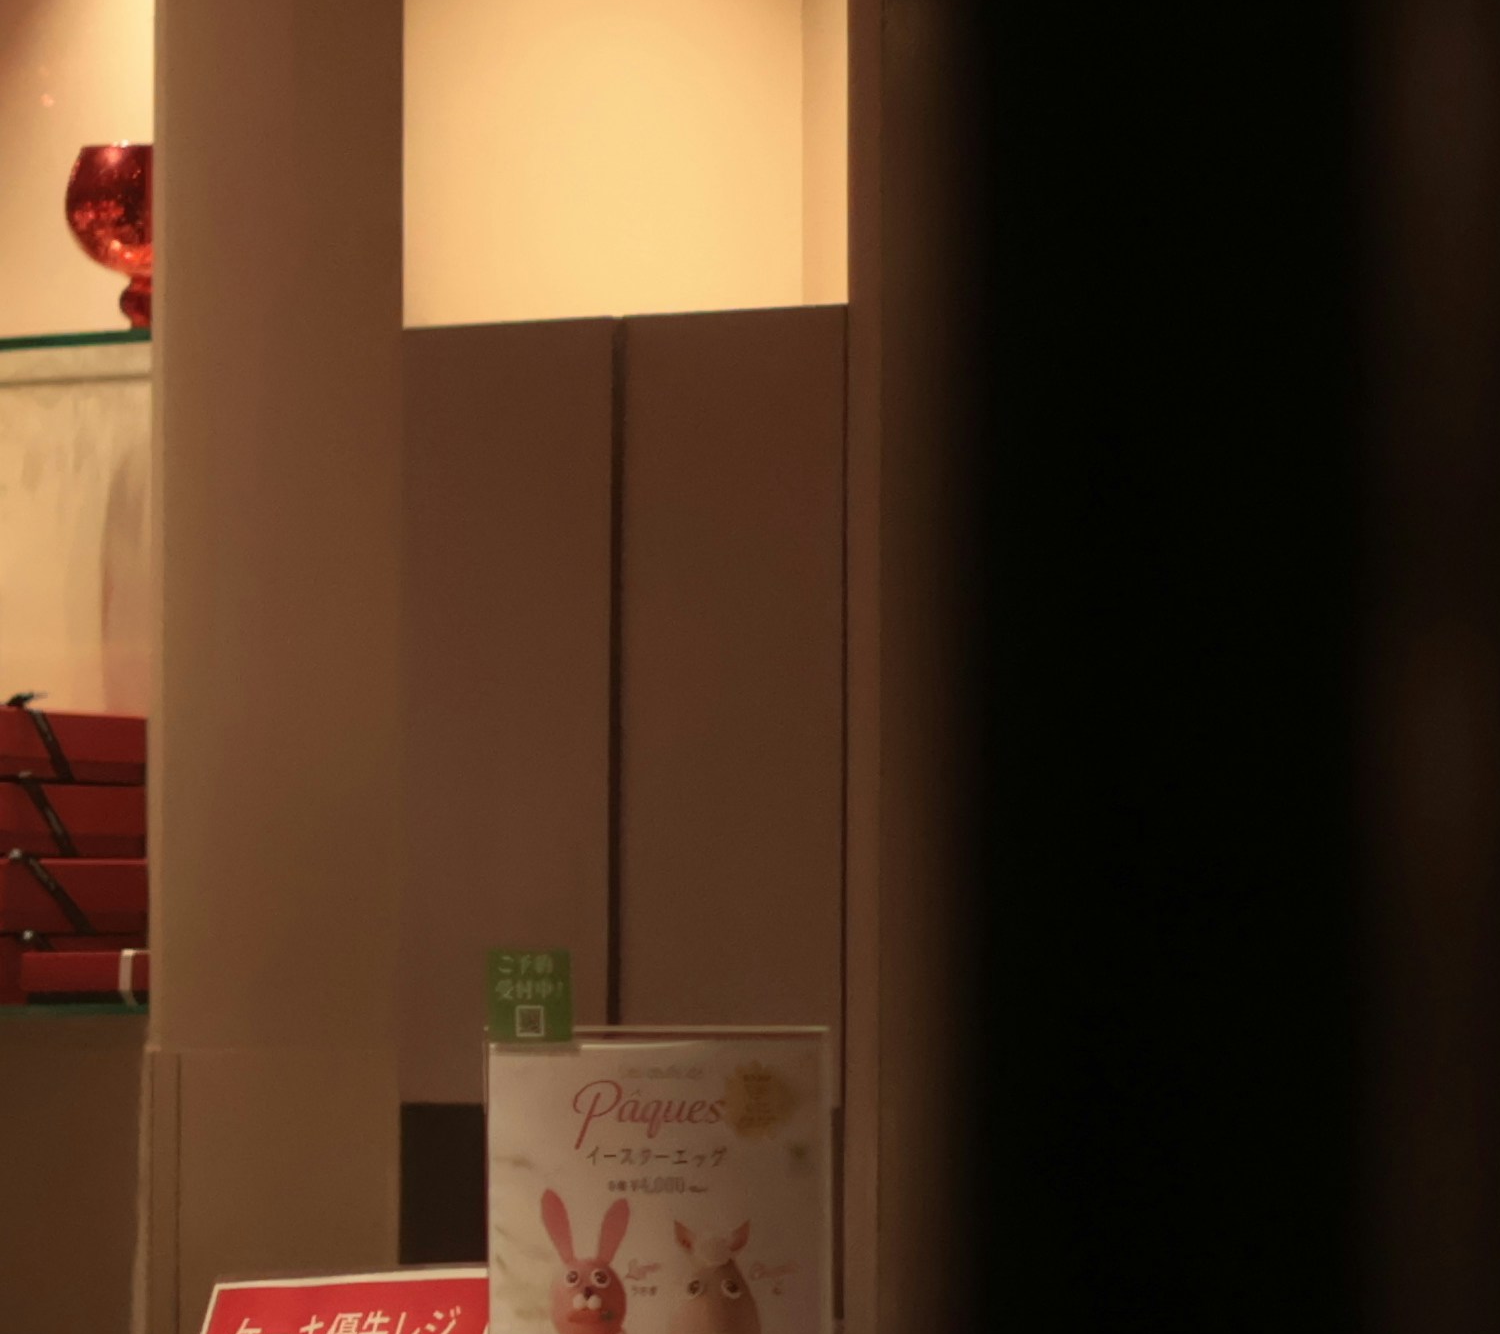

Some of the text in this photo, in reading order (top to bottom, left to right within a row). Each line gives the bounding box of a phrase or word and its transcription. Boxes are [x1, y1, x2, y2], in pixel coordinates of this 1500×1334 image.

[572, 1079, 727, 1150] Pâques
[585, 1145, 728, 1168] イースターエッグ
